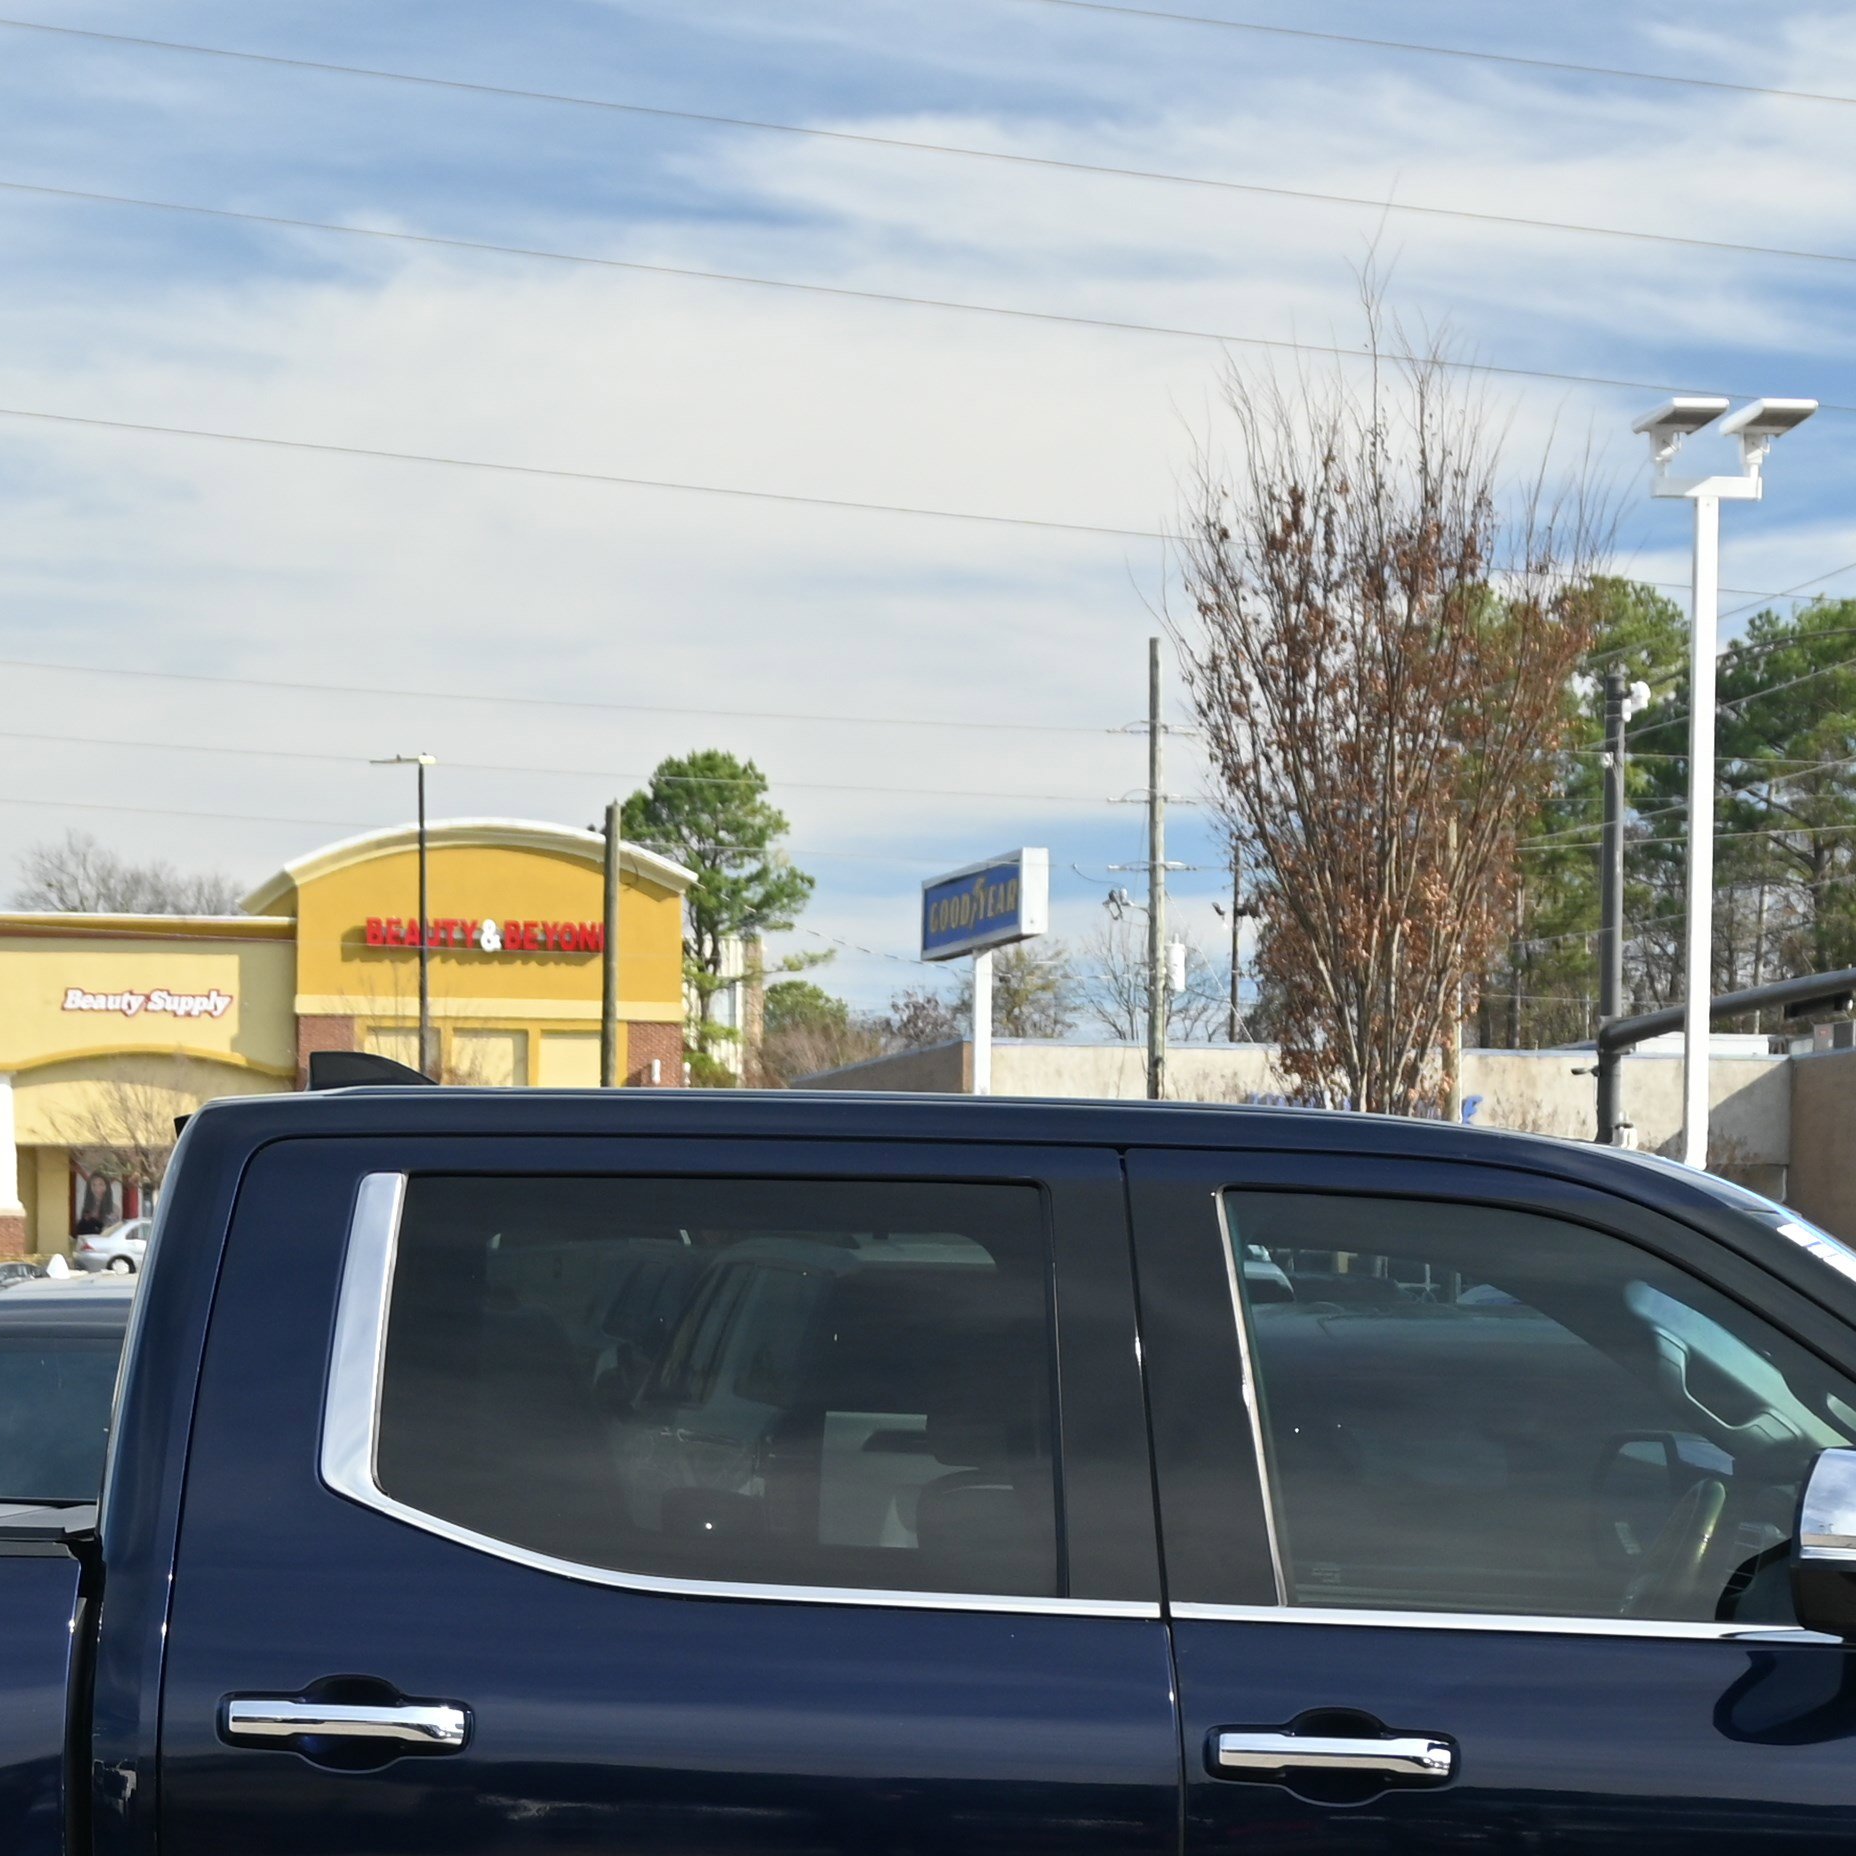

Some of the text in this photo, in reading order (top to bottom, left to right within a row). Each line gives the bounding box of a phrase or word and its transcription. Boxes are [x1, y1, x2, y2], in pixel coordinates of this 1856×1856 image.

[929, 876, 1019, 934] GOODYEAR
[366, 917, 606, 954] BEAUTY & BEYON
[62, 987, 233, 1018] Beauty Supply
